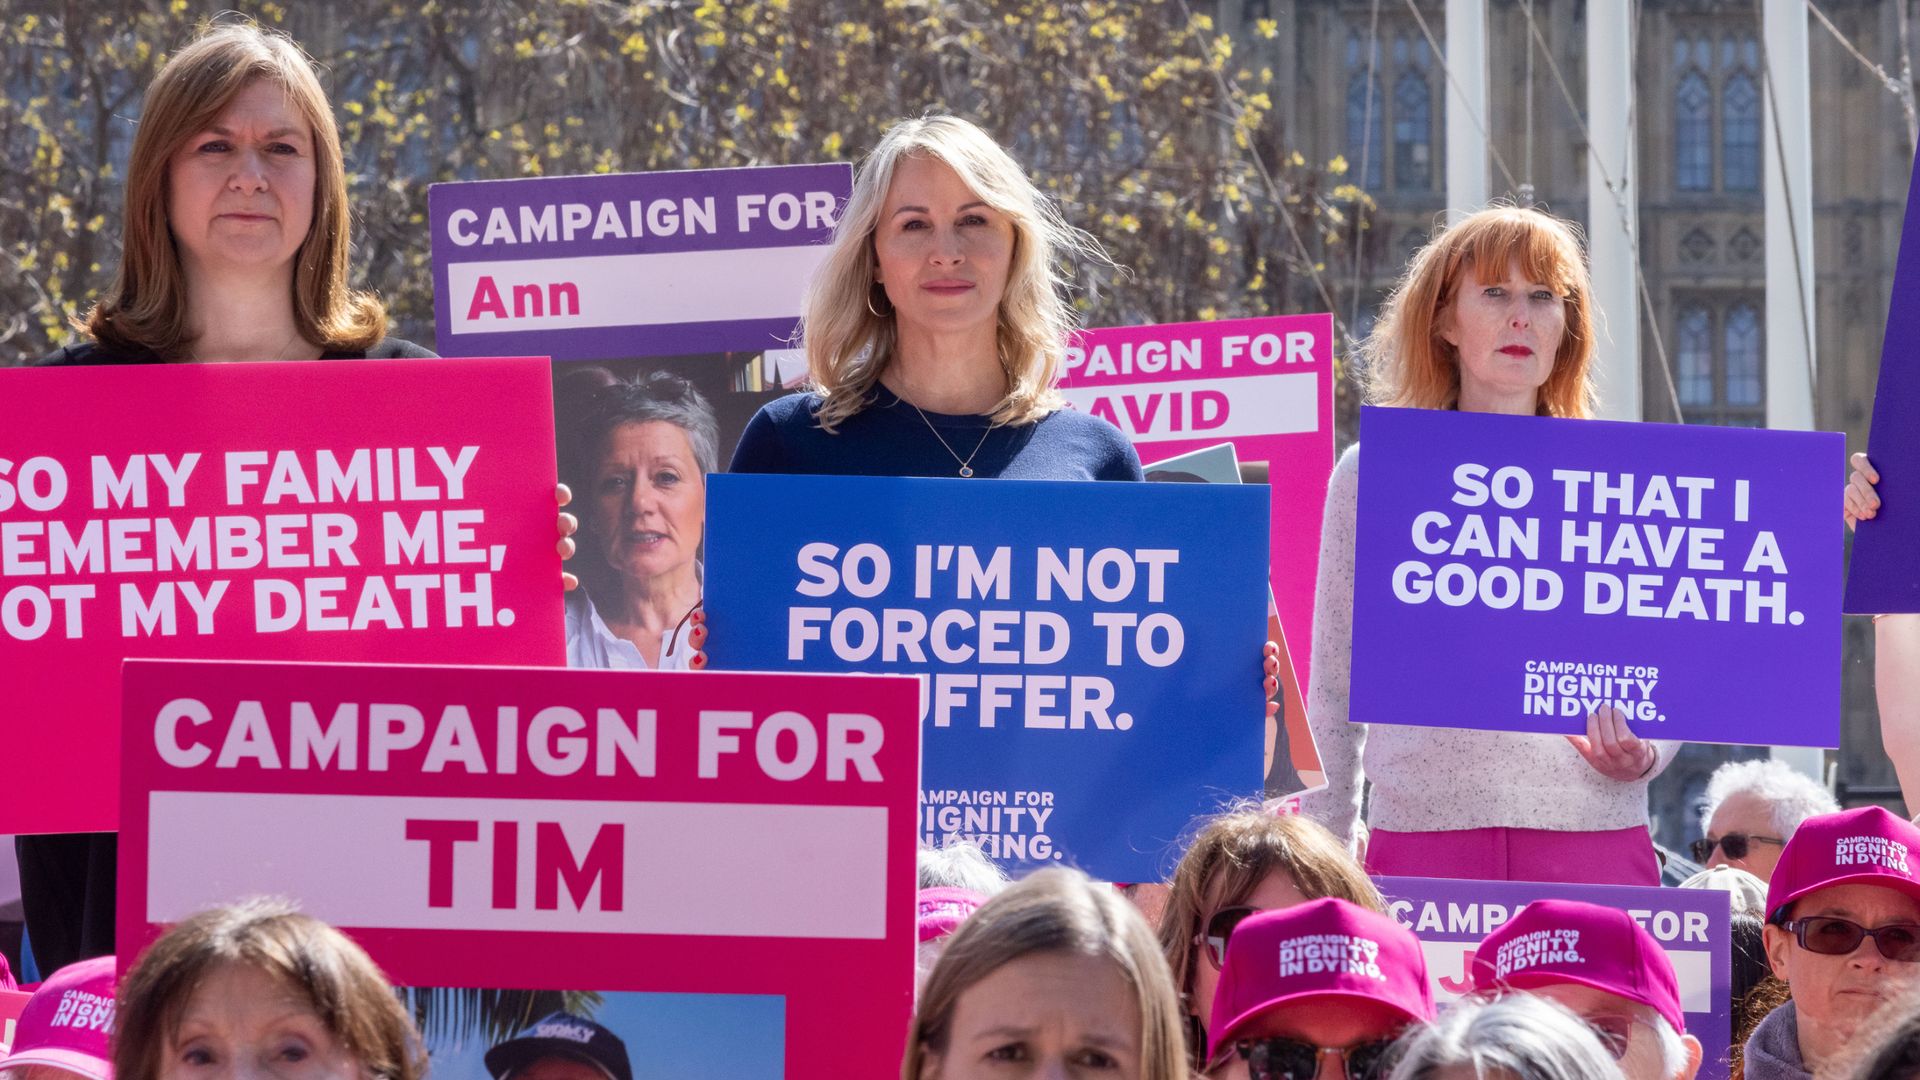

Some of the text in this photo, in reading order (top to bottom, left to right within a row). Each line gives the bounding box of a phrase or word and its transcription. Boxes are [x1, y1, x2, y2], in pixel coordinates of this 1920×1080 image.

[447, 191, 837, 247] CAMPAIGN FOR
[467, 276, 580, 320] Ann
[1058, 331, 1315, 379] PAIGN FOR
[1090, 390, 1230, 434] AVID
[92, 453, 201, 509] MY
[225, 446, 480, 505] FAMILY
[1452, 464, 1750, 522] SO THAT I
[1, 509, 506, 575] EMEMBER ME,
[1411, 511, 1788, 574] CAN HAVE A
[796, 543, 1180, 602] SO I'M NOT
[1, 573, 515, 640] OT MY DEATH.
[1392, 561, 1805, 626] GOOD DEATH.
[788, 606, 1185, 667] FORCED TO
[1525, 660, 1659, 679] CAMPAIGN FOR
[1524, 673, 1658, 700] DIGNITY
[921, 673, 1134, 731] FFER.
[1523, 694, 1666, 722] IN DYNG.
[155, 699, 885, 782] CAMPAIGN FOR
[919, 789, 1054, 806] AMPAIGN FOR
[919, 806, 1054, 832] IGNITY
[1836, 836, 1908, 852] CAMPAIGN FOR
[1836, 843, 1908, 862] DIGNITY
[405, 819, 625, 912] TIM
[1836, 853, 1912, 876] IN DYING.
[1390, 901, 1526, 933] CAMP
[1280, 934, 1379, 950] CAMPAIGN FOR
[1280, 943, 1379, 963] DIGNITY
[1497, 928, 1580, 954] CAMPAIGN FOR
[1497, 938, 1579, 967] DIGNITY
[1280, 958, 1386, 981] IN DYING.
[1496, 961, 1511, 979] IN
[1514, 950, 1585, 971] DYING.
[63, 989, 115, 1008] CAMPAIG
[50, 1012, 74, 1027] IN
